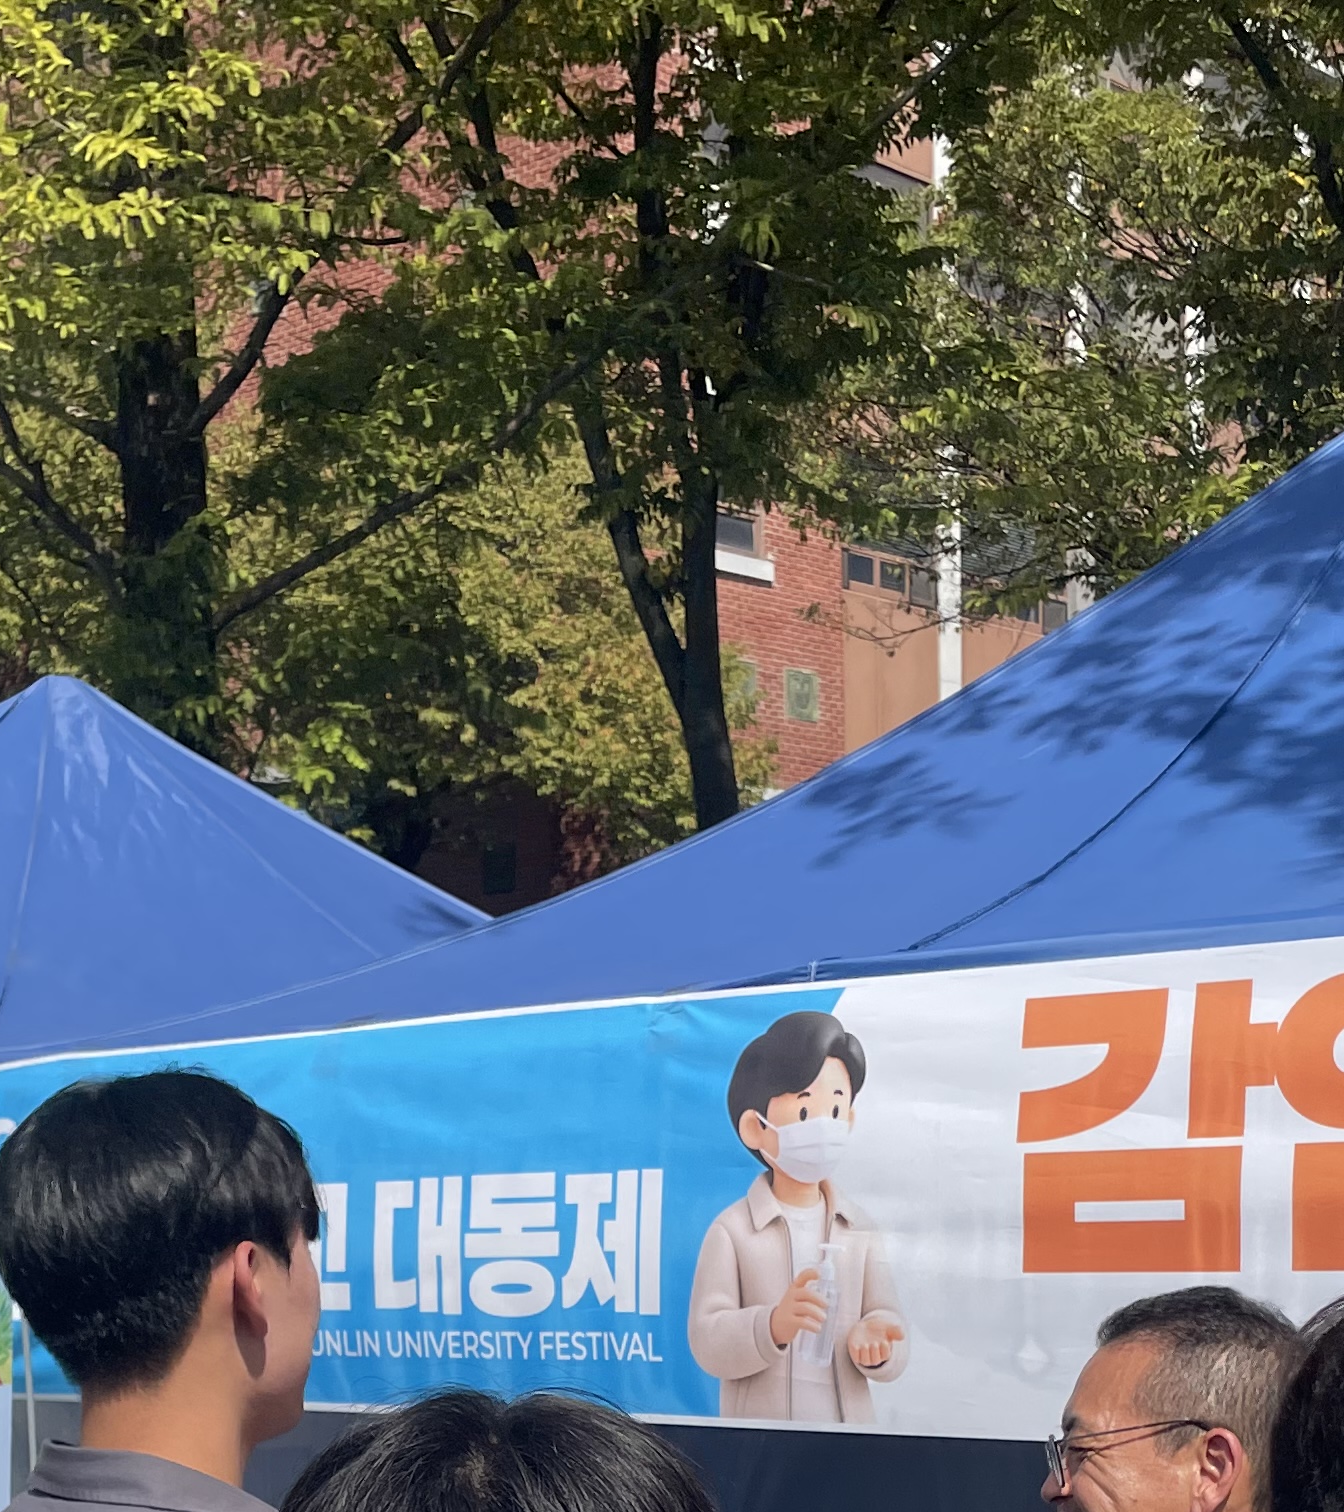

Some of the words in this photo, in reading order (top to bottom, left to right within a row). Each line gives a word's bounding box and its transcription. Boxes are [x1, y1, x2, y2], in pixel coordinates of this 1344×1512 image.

[372, 1168, 664, 1318] 대동제
[312, 1329, 381, 1357] UNLIN
[386, 1330, 533, 1361] UNIVERSITY
[538, 1331, 664, 1363] FESTIVAL
